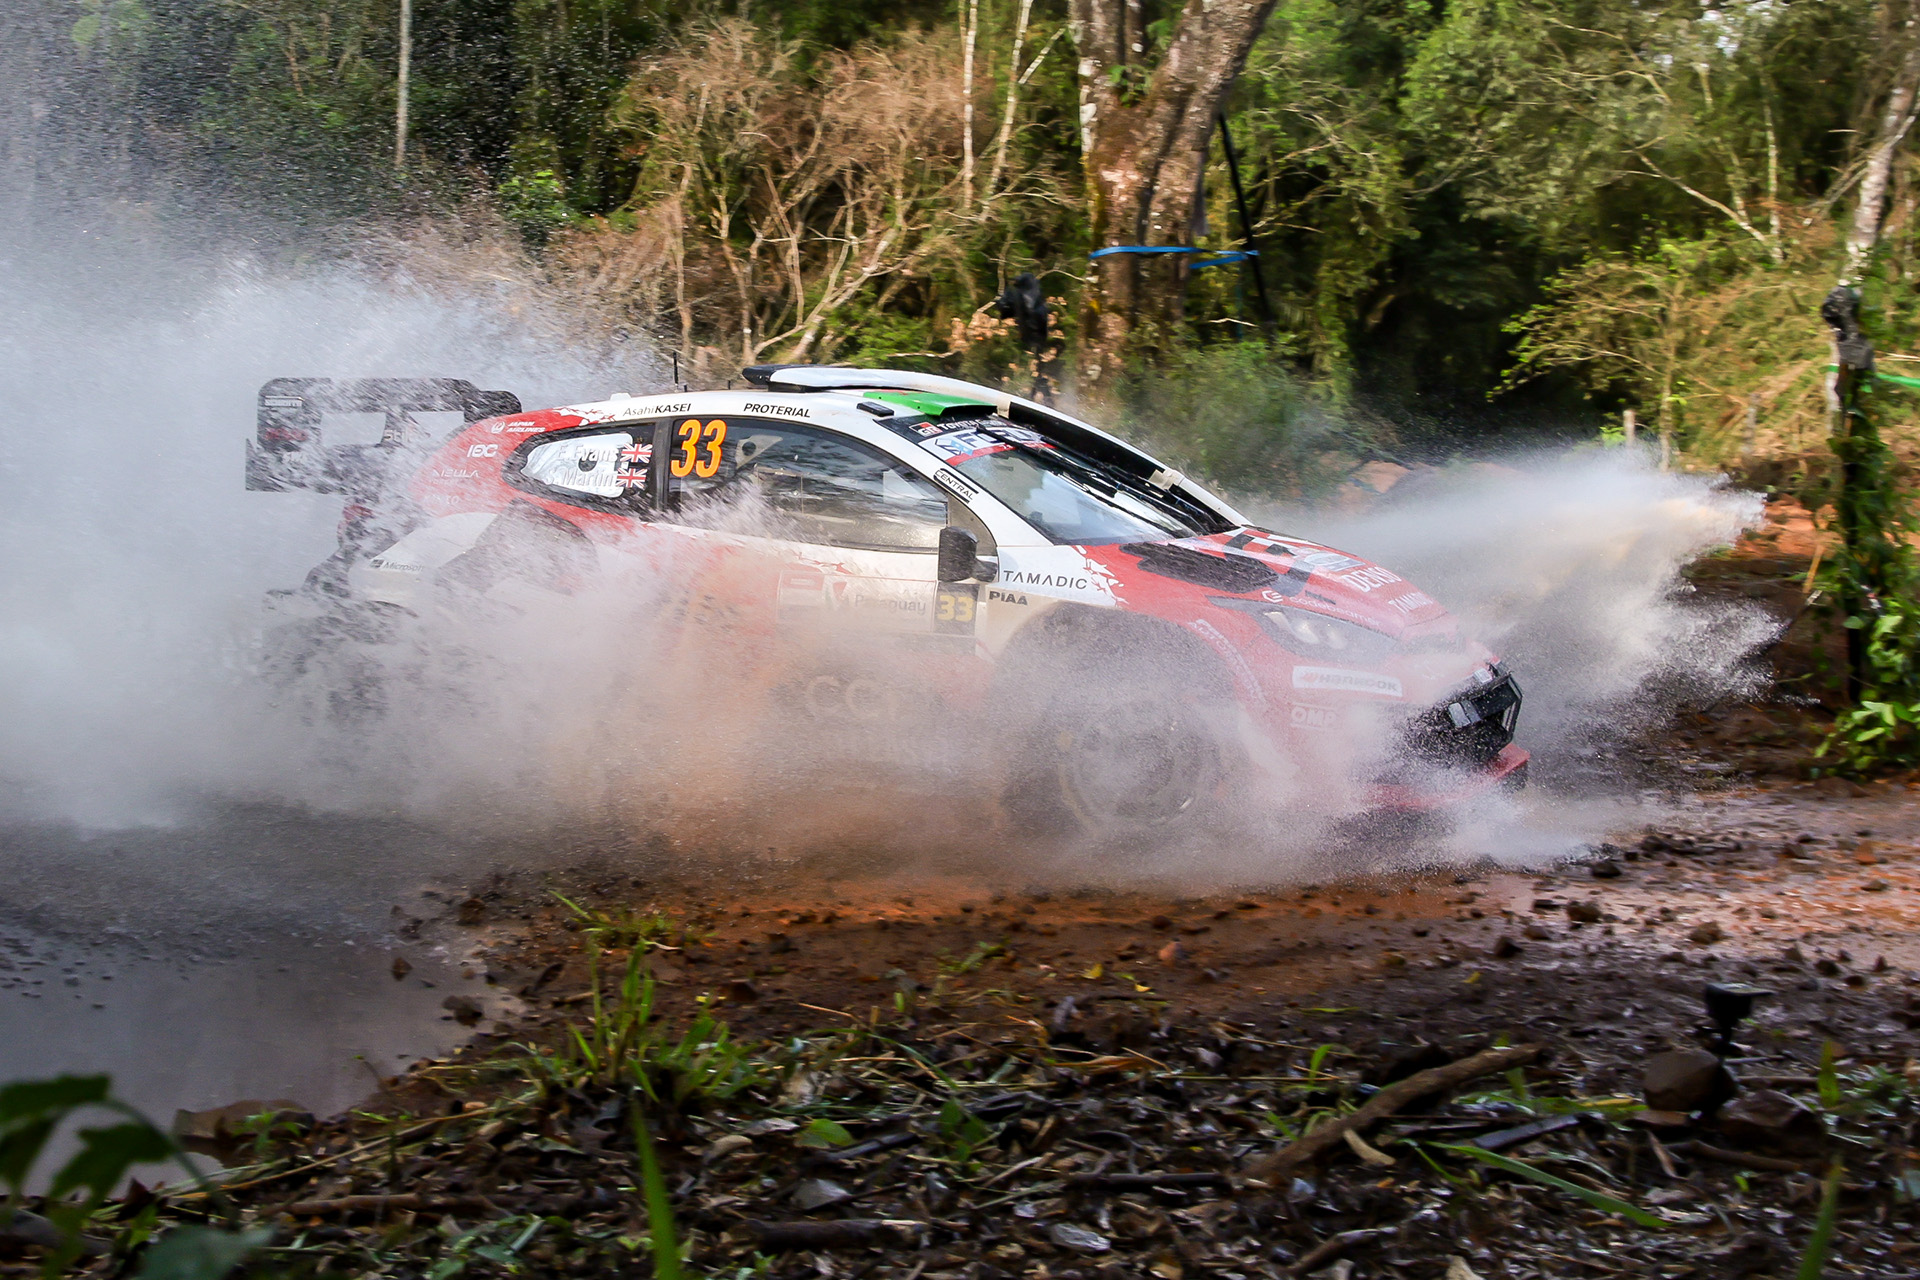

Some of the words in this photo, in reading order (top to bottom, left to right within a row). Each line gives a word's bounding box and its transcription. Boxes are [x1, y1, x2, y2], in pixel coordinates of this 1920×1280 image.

[743, 402, 811, 418] PROTERIAL
[574, 444, 619, 462] Evans
[670, 418, 728, 478] 33
[562, 468, 614, 487] Martin
[934, 469, 974, 501] CENTRAL
[1003, 570, 1087, 589] TAMADIC
[1341, 566, 1402, 593] DENSO
[937, 594, 974, 622] 33
[988, 591, 1028, 605] PIAA
[1291, 706, 1338, 727] OMP
